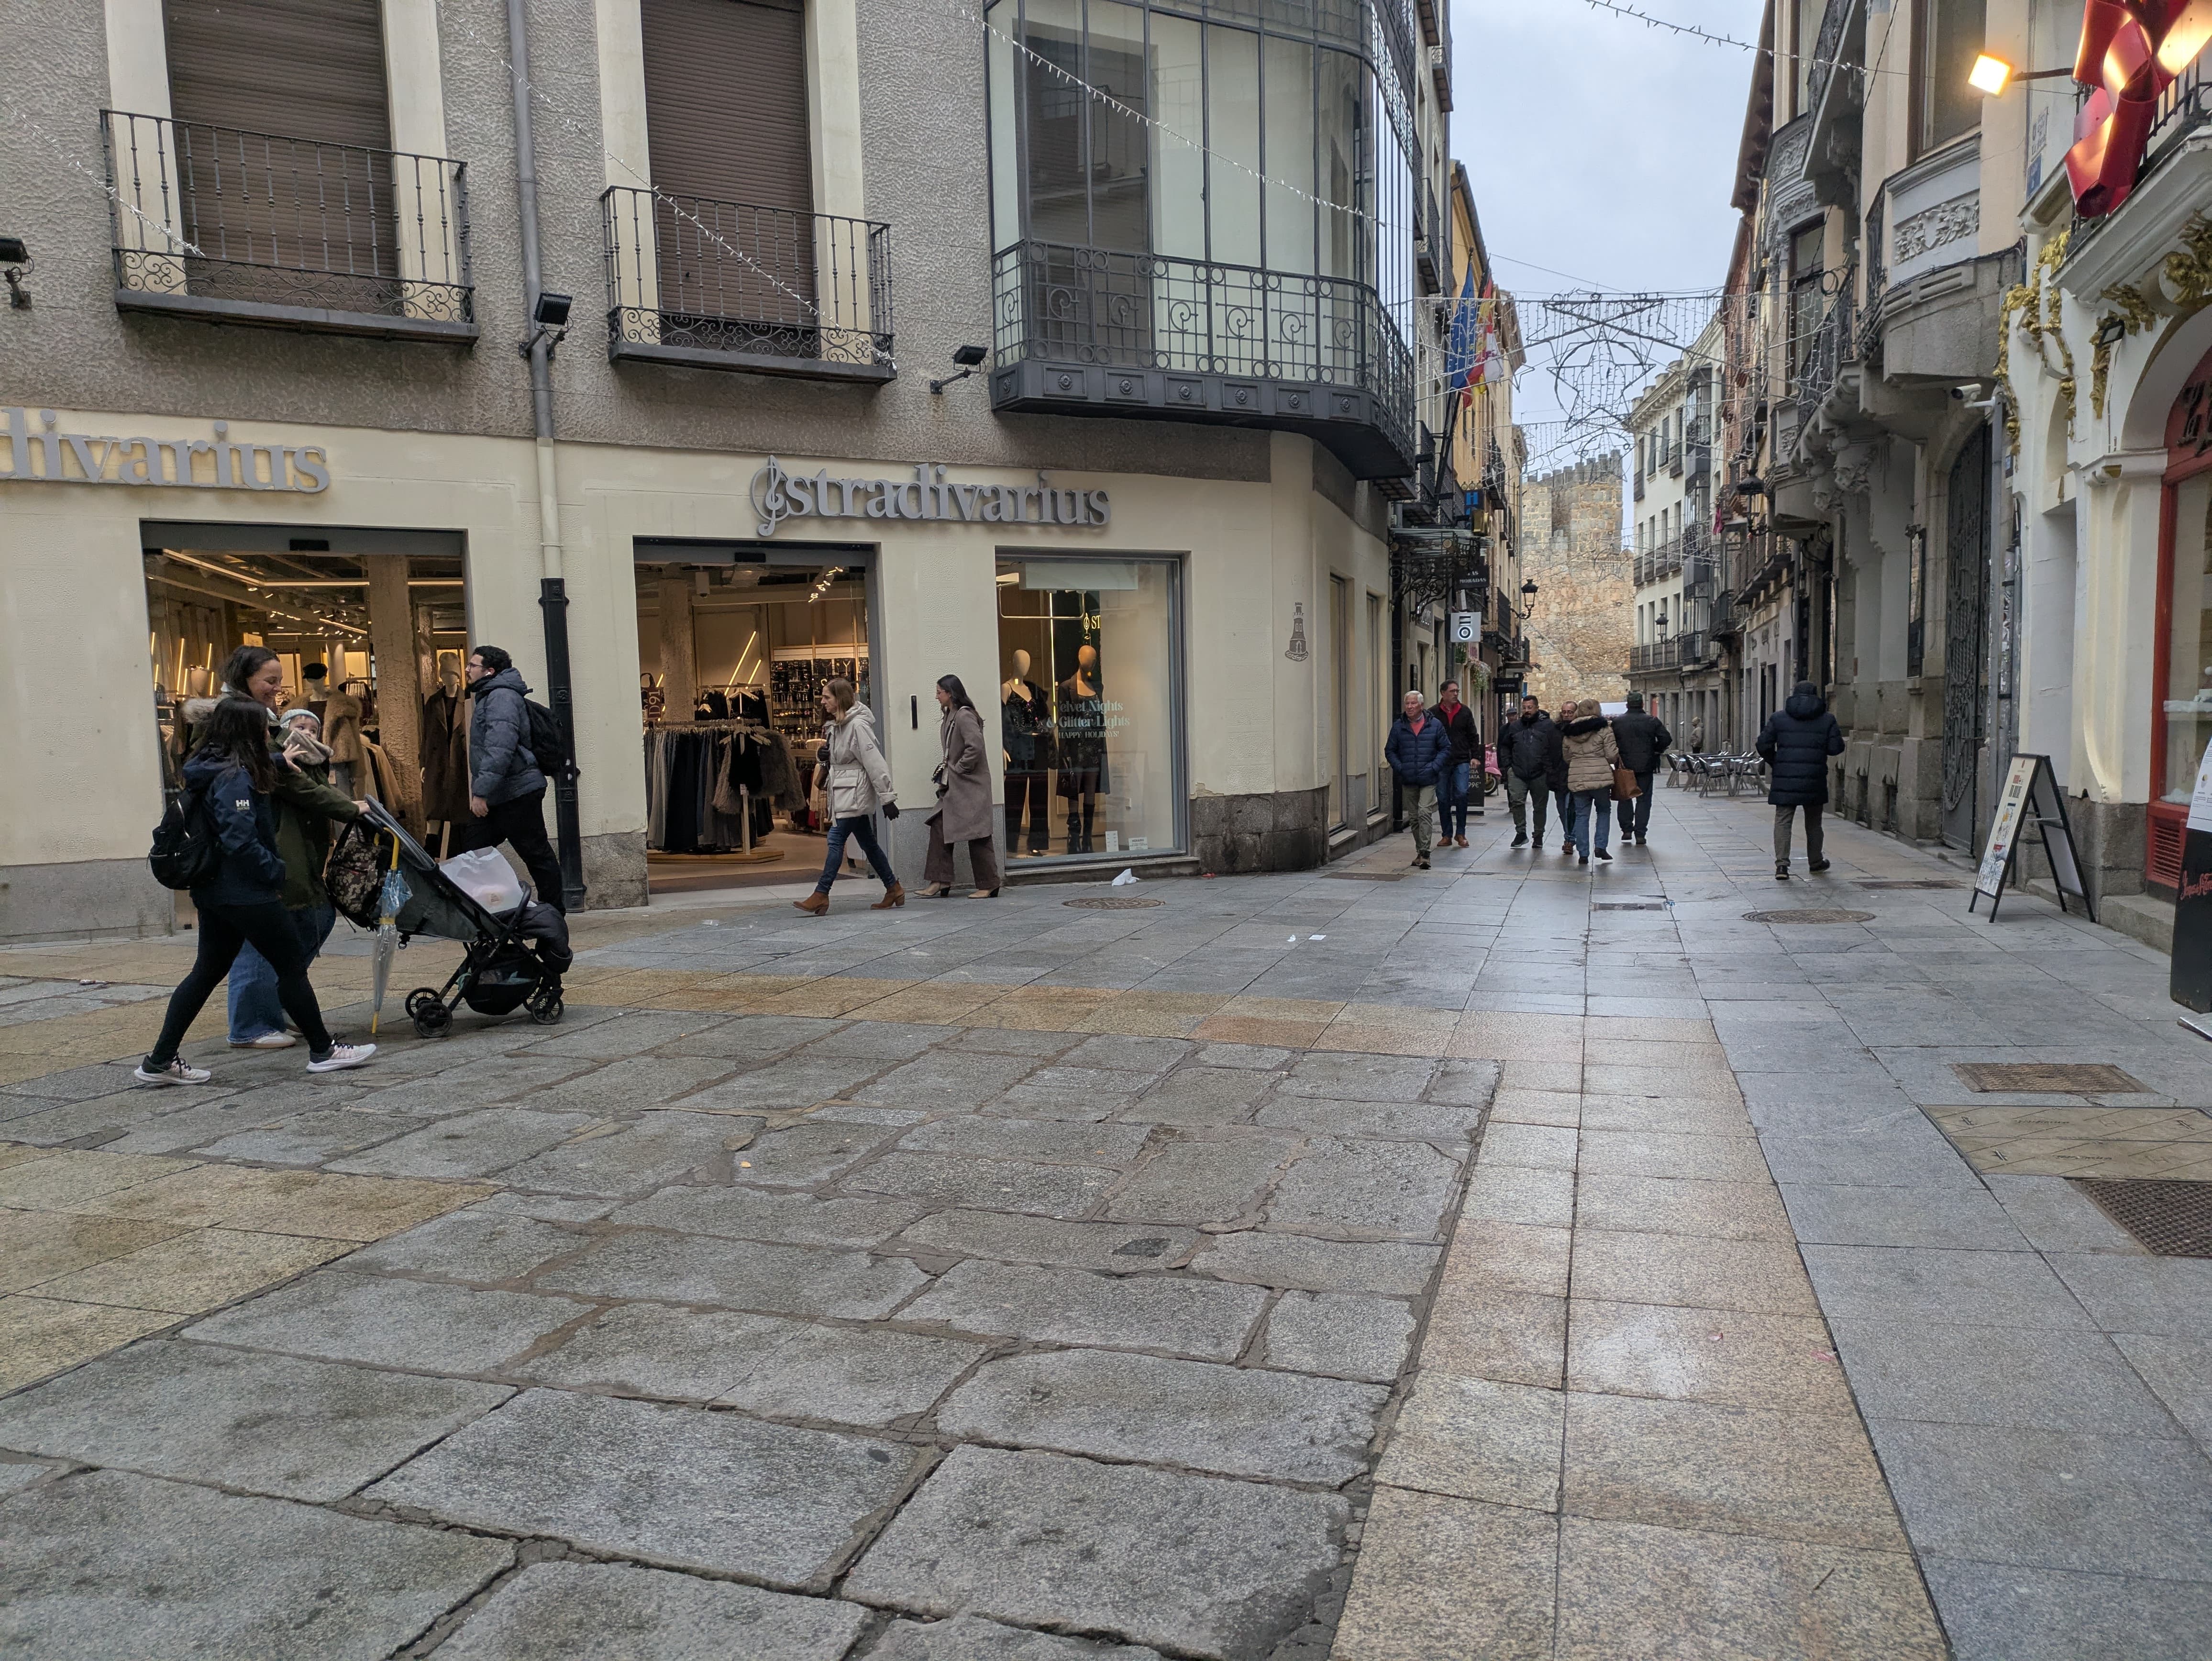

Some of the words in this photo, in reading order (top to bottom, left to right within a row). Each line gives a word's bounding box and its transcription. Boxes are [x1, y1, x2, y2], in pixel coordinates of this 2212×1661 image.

[785, 463, 1112, 525] stradivarius
[1059, 701, 1086, 712] elvet
[1088, 700, 1123, 714] Nights
[1059, 716, 1094, 728] Glitter
[1096, 715, 1130, 729] Lights
